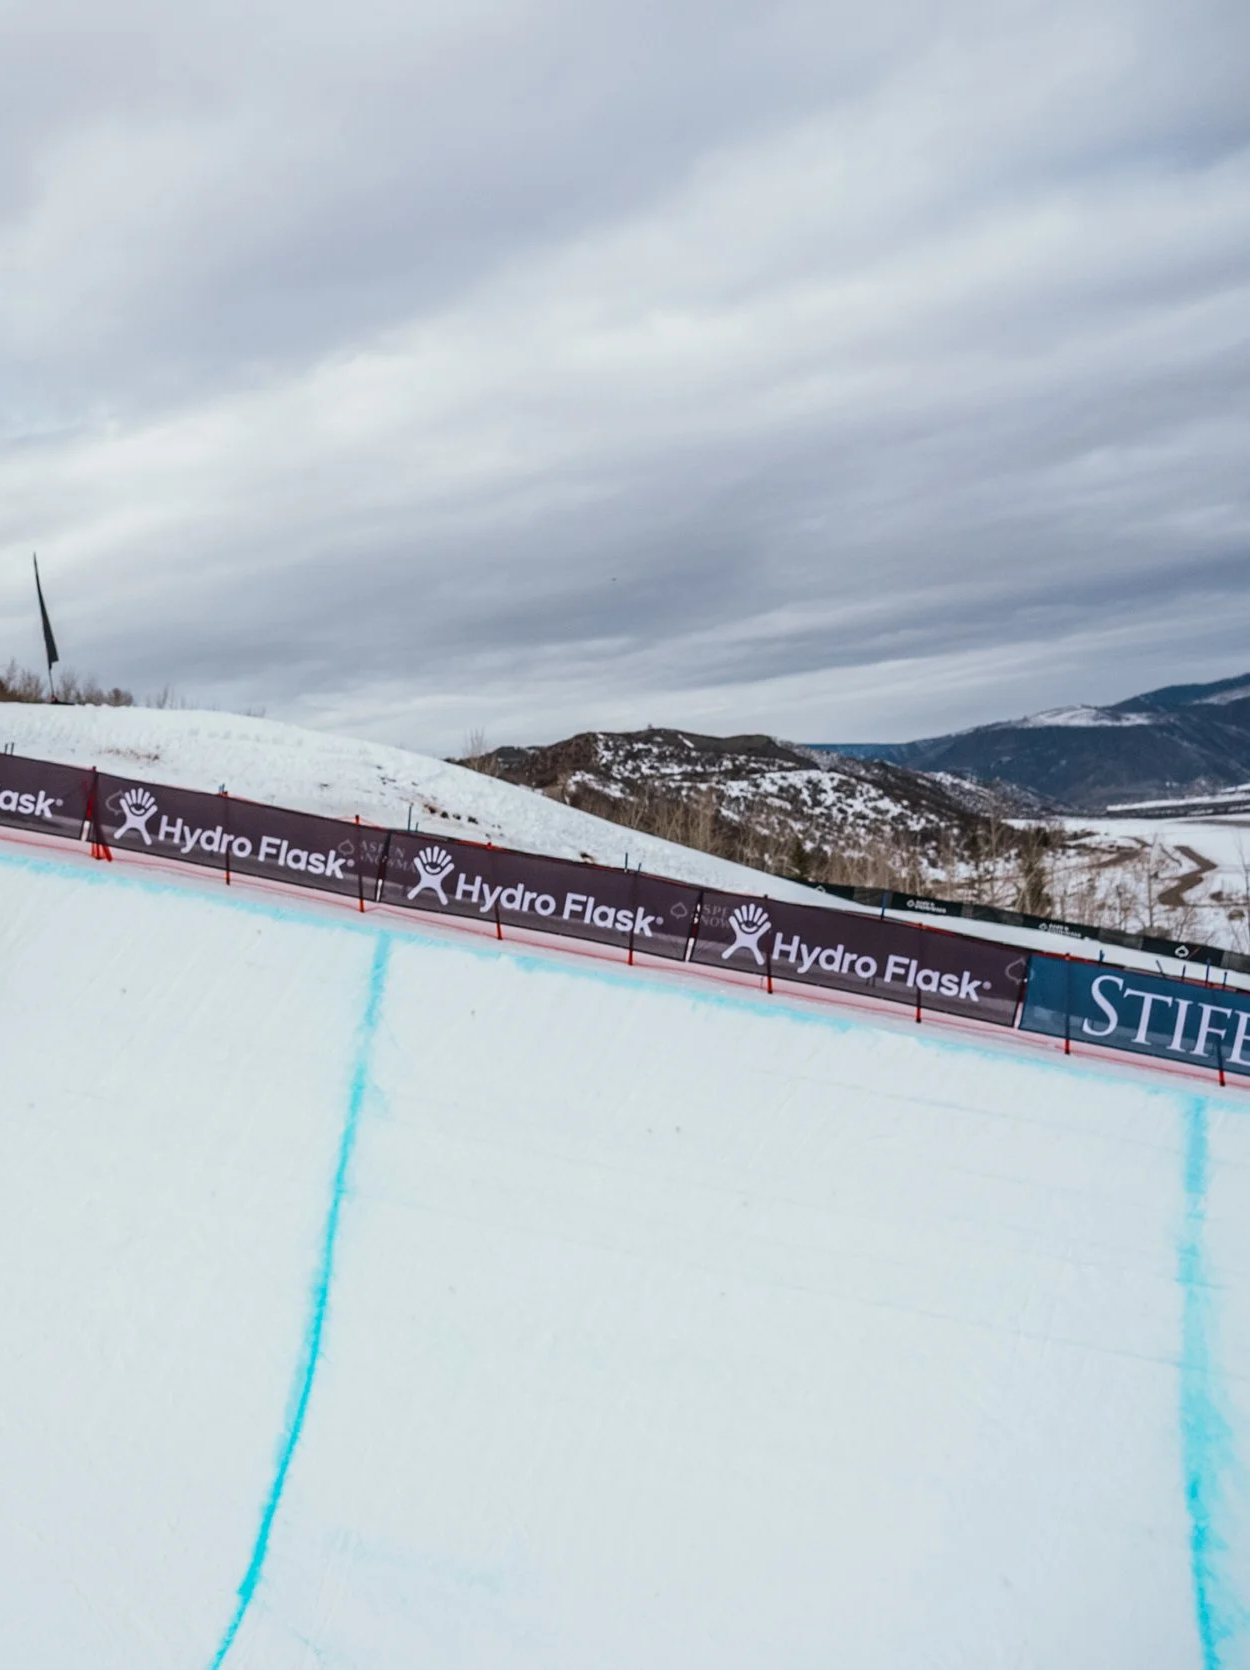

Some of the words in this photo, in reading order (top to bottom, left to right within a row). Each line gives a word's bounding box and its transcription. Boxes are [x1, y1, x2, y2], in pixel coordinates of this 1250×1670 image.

[158, 815, 251, 858] Hydro
[258, 835, 345, 880] Flask
[454, 872, 555, 917] Hydro
[561, 893, 655, 938] Flask
[771, 932, 878, 980] Hydro
[884, 954, 981, 1002] Flask
[1082, 974, 1250, 1067] STIFE
